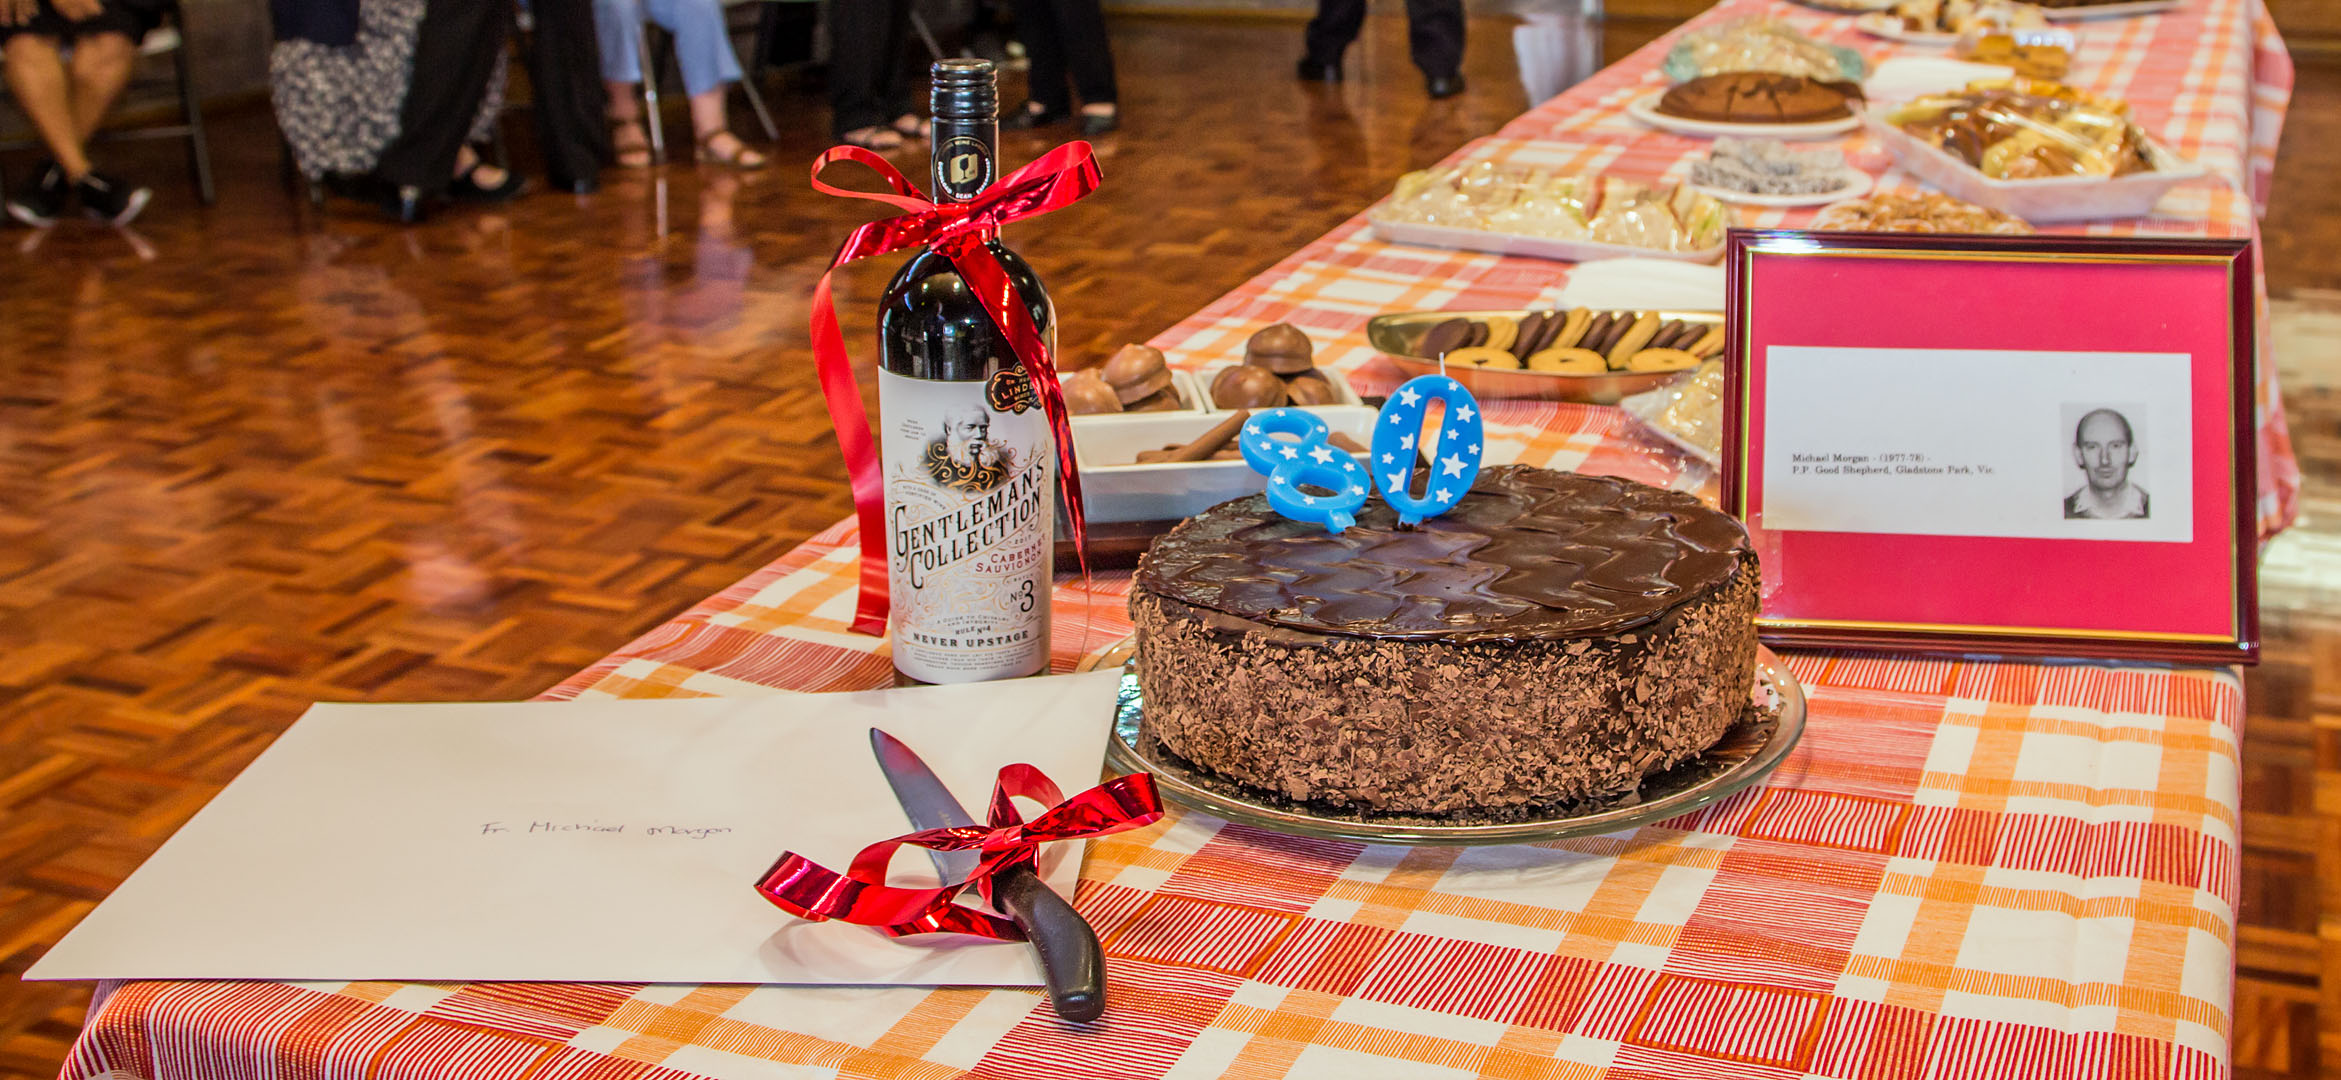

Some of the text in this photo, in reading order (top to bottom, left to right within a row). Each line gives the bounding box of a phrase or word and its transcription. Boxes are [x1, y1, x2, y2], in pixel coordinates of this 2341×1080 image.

[1792, 453, 1830, 463] Michael
[1833, 453, 1870, 464] Morgan
[1815, 466, 1840, 475] Good
[1842, 465, 1893, 476] Shepherd,
[1895, 465, 1944, 475] Gladstone
[1947, 465, 1975, 476] Park,
[911, 487, 1040, 590] COLLECTION
[990, 532, 1046, 564] CABERNET
[955, 625, 975, 635] RULE
[913, 632, 958, 647] NEVER
[966, 630, 1029, 648] UPSTAGE
